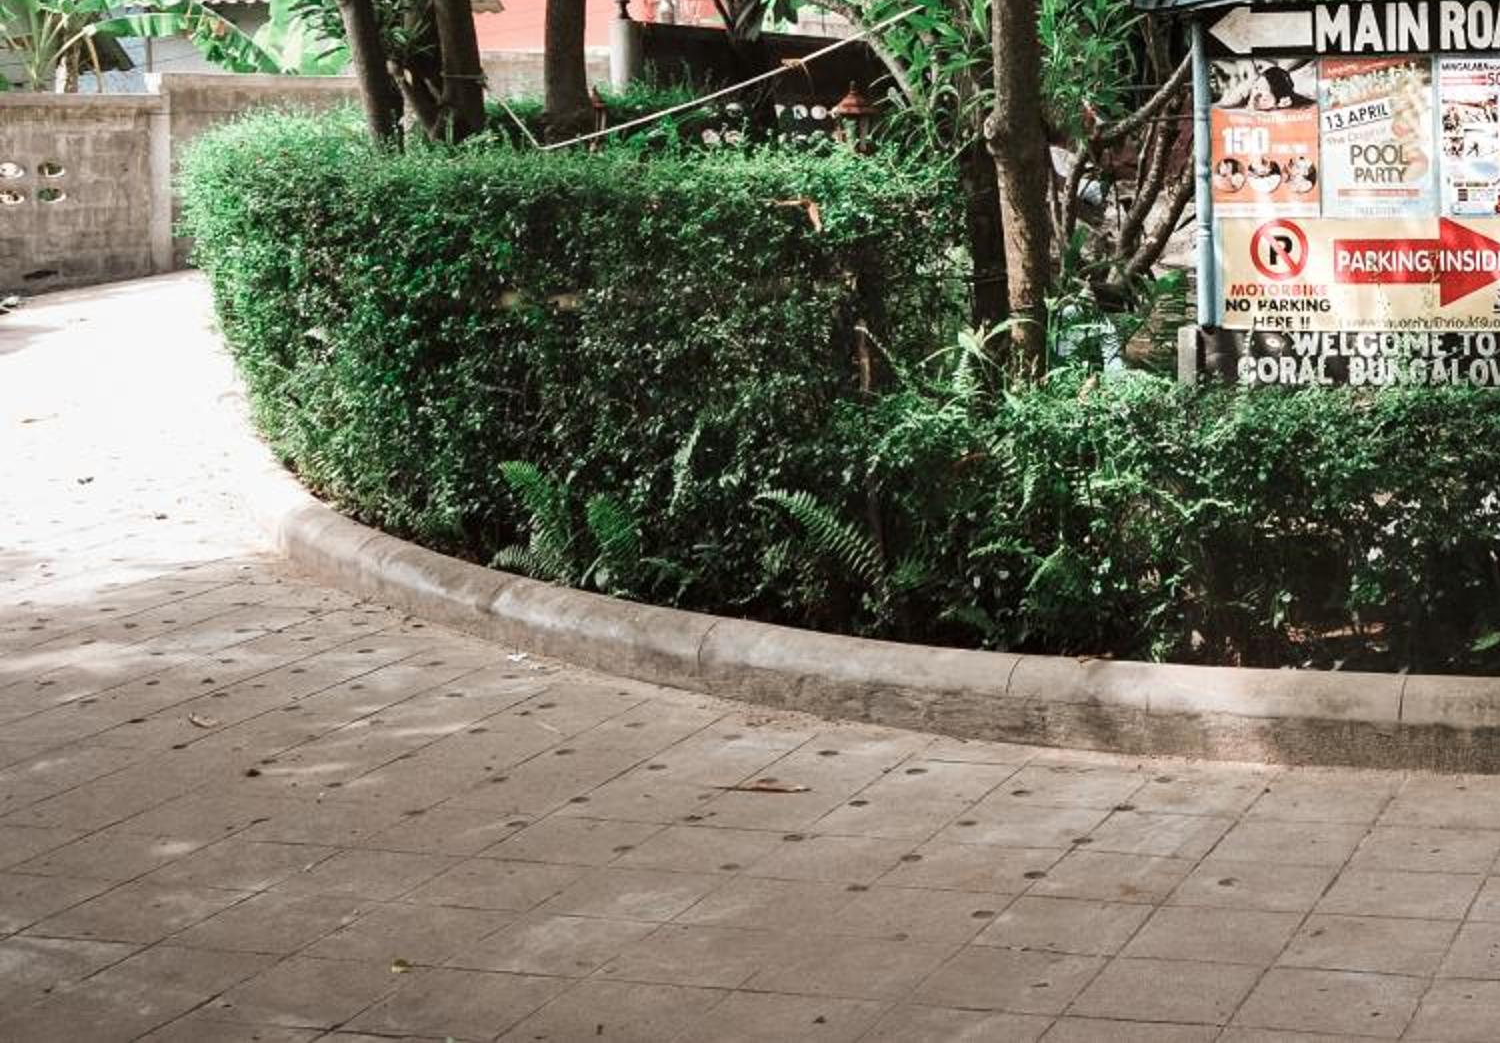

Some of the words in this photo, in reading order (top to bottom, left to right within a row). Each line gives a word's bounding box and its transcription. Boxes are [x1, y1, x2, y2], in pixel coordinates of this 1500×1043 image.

[1315, 1, 1429, 52] MAIN
[1326, 113, 1344, 130] 13
[1348, 104, 1389, 124] APRIL
[1350, 144, 1409, 166] POOL
[1354, 166, 1407, 183] PARTY
[1336, 250, 1431, 272] PARKING
[1231, 284, 1328, 297] MOTORBIKE
[1225, 299, 1250, 312] NO
[1258, 299, 1331, 312] PARKING
[1253, 316, 1294, 328] HERE
[1294, 332, 1447, 356] WELCOME
[1456, 332, 1496, 356] TO
[1237, 357, 1333, 384] CORAL
